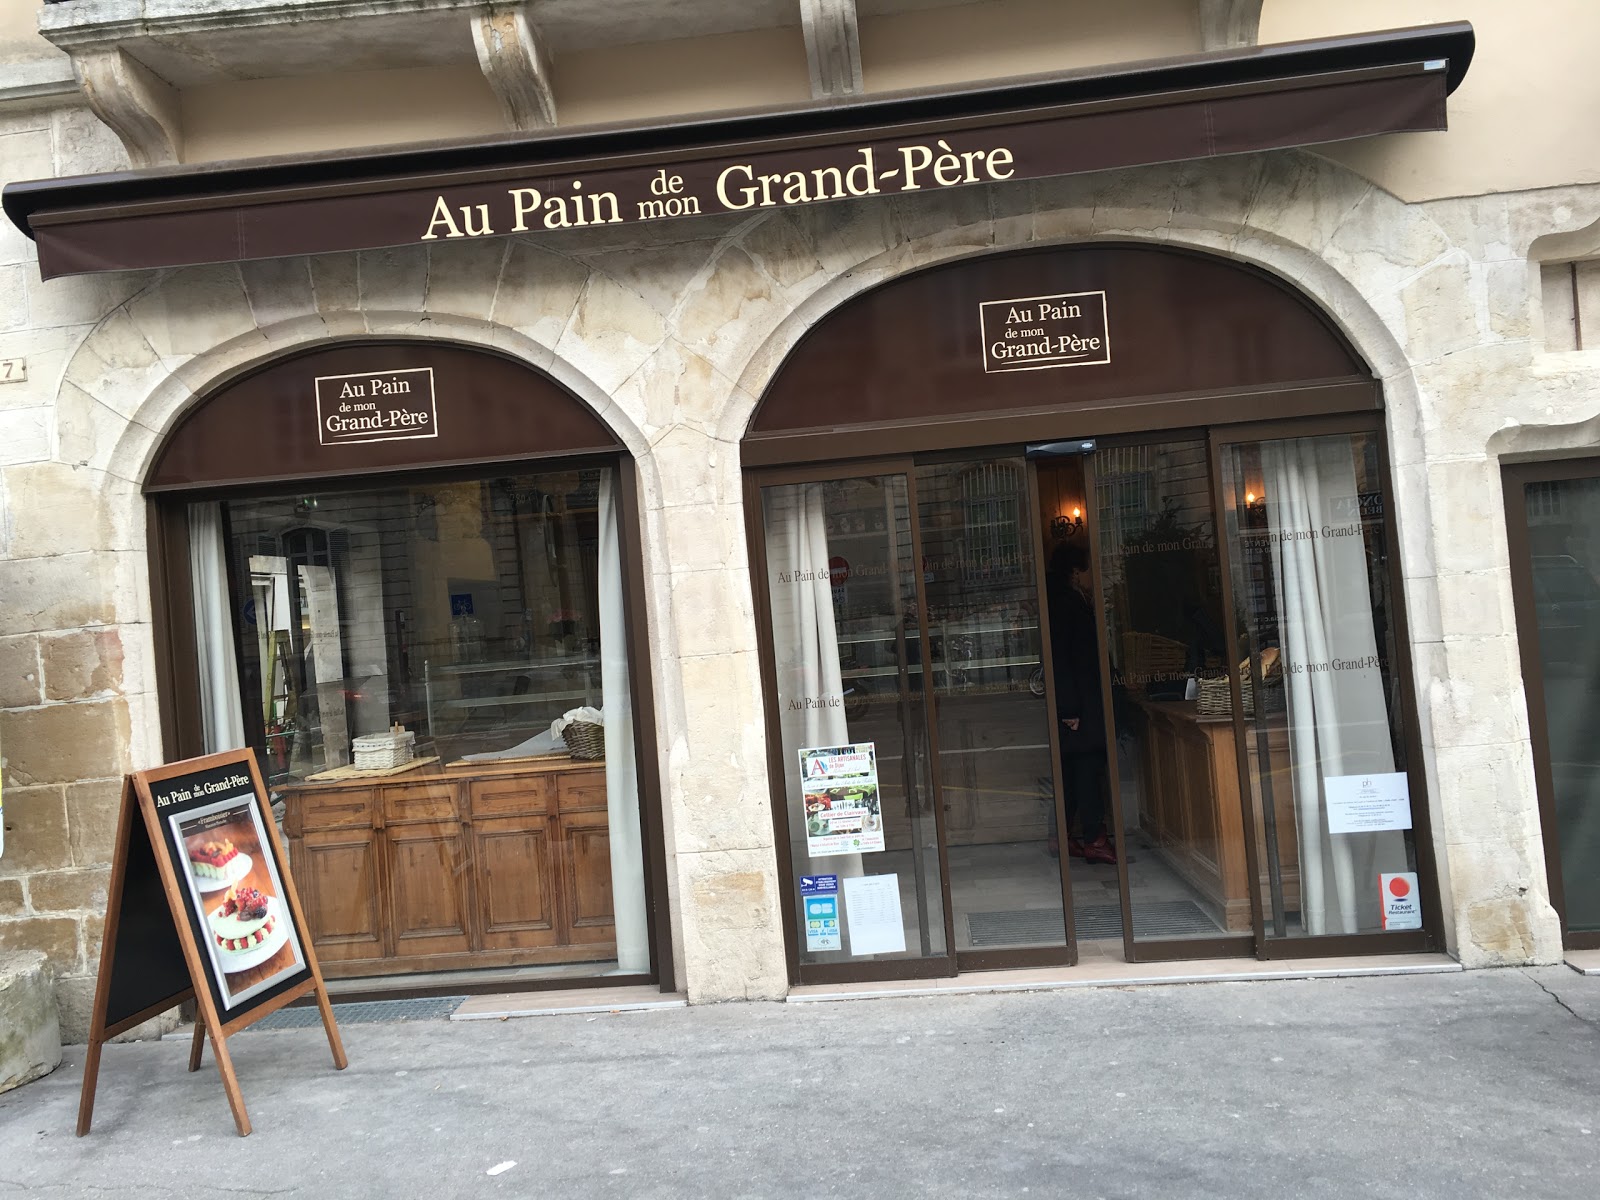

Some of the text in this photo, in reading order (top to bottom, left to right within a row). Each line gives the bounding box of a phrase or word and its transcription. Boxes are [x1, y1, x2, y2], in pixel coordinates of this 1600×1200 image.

[421, 139, 1015, 240] Au Pain de mon Grand-Père
[1005, 300, 1082, 324] Au Pain
[1005, 328, 1045, 339] de mon
[991, 334, 1100, 359] Grand-Père
[339, 376, 411, 399] Au Pain
[339, 402, 376, 413] de mon
[326, 408, 429, 432] Grand-Père
[1280, 529, 1293, 541] de
[1295, 530, 1319, 540] mon
[1142, 540, 1154, 553] de
[1157, 542, 1180, 552] mon
[778, 571, 792, 583] Au
[794, 568, 815, 582] Pain
[818, 567, 830, 580] de
[1290, 661, 1303, 673] de
[1306, 662, 1329, 673] mon
[1154, 669, 1166, 682] de
[788, 695, 840, 711] Au Pain de
[157, 794, 171, 808] Au
[170, 788, 192, 803] Pain
[203, 774, 250, 795] Grand-Père
